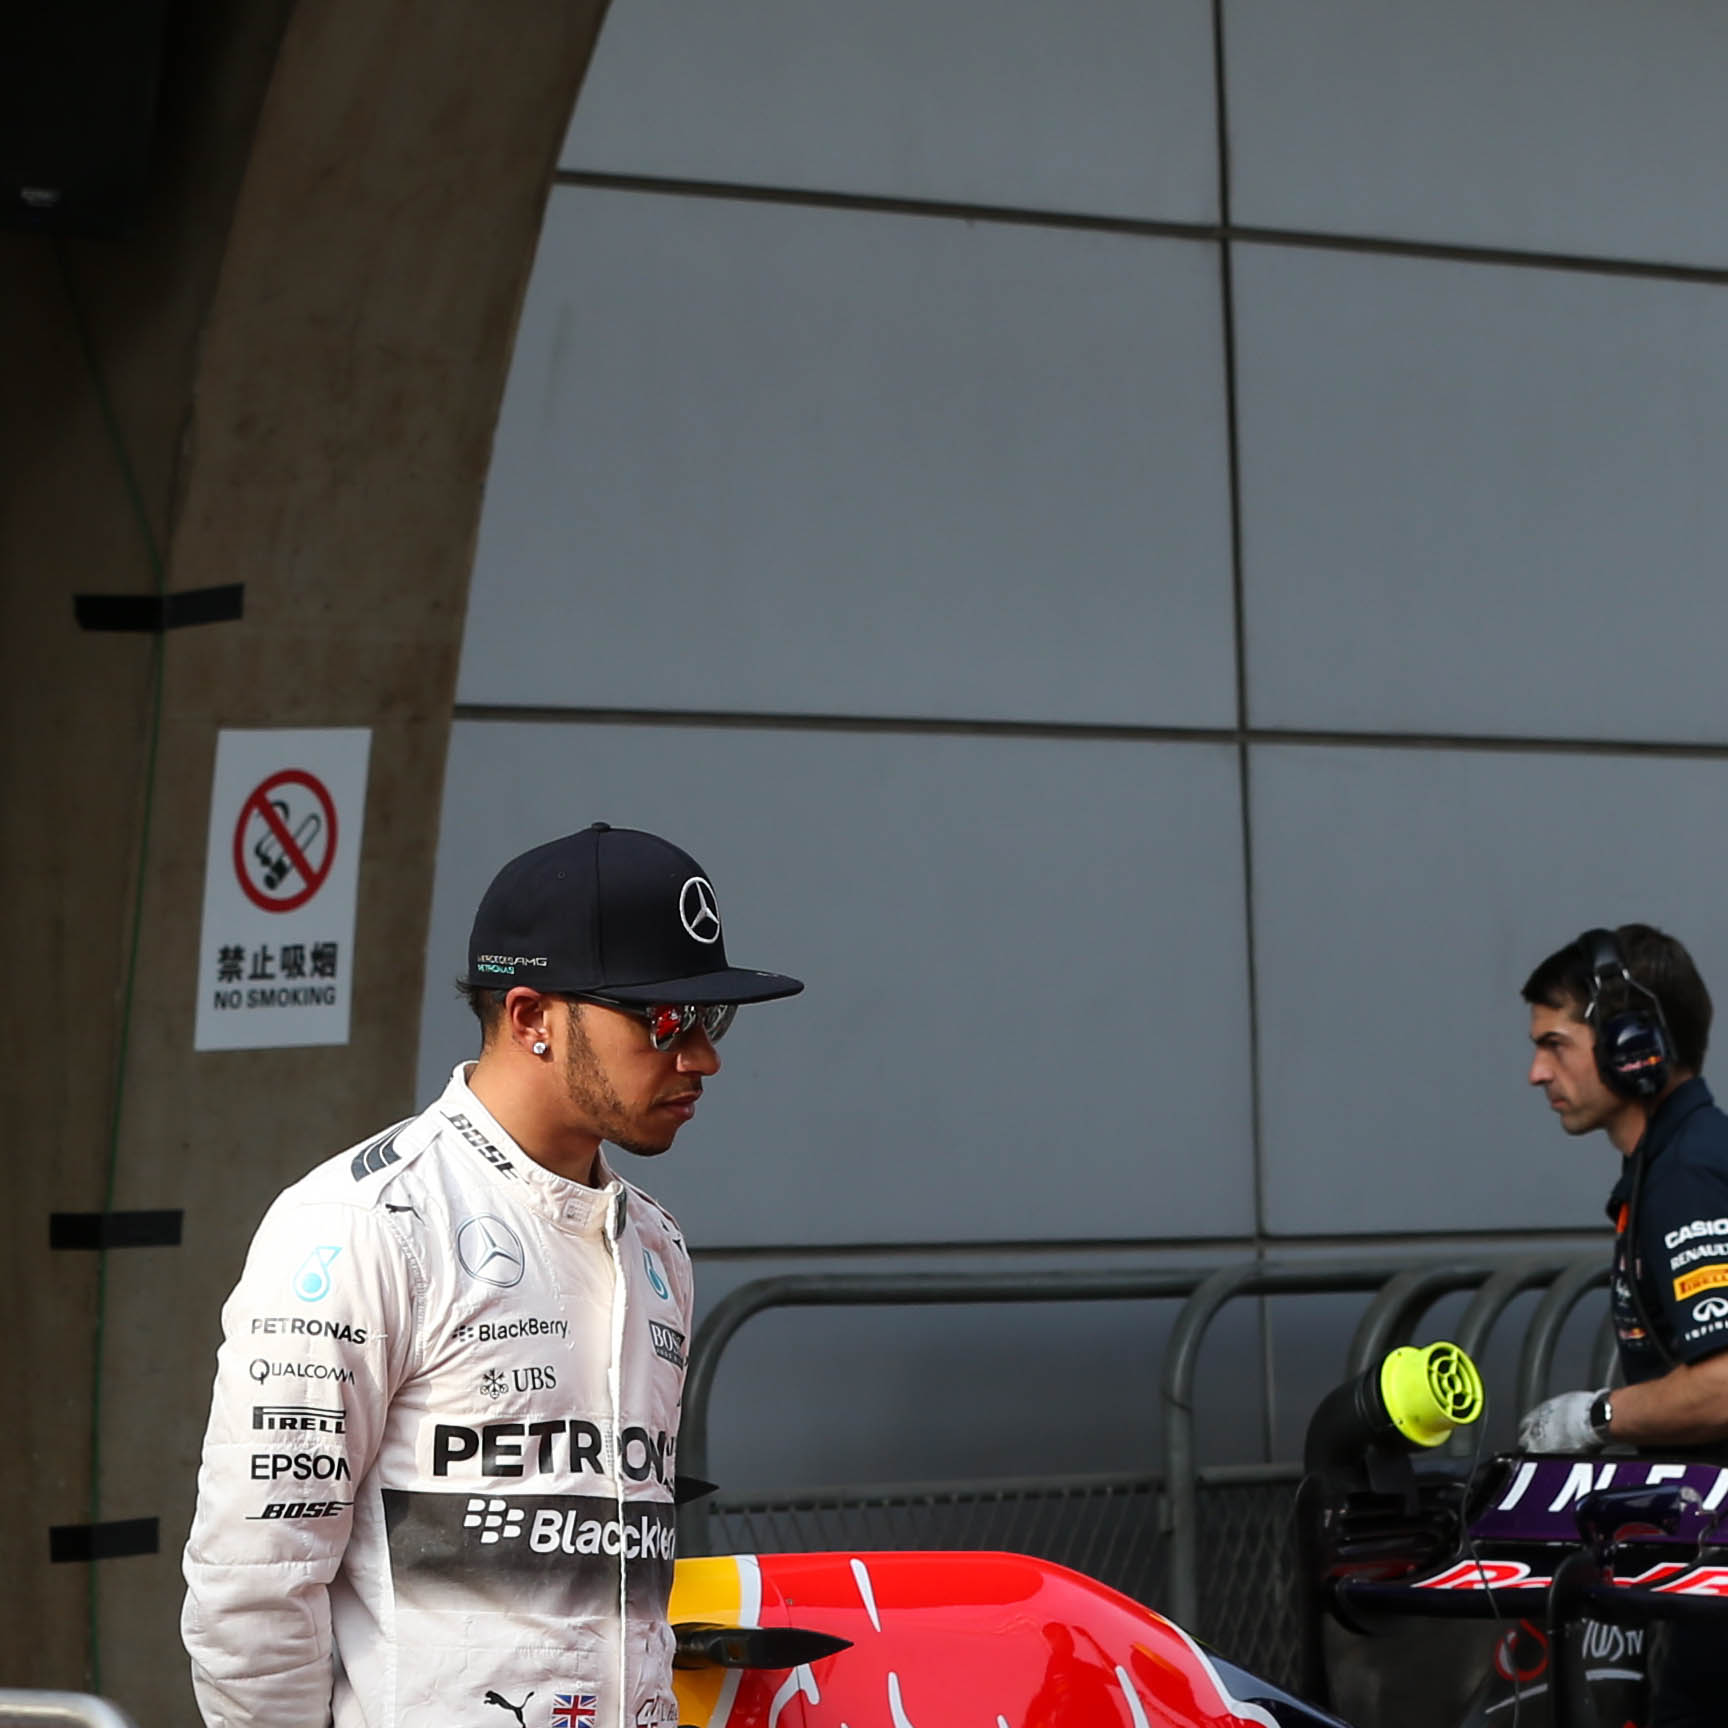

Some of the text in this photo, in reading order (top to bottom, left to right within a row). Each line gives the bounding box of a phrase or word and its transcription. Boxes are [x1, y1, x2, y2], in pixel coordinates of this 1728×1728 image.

[216, 942, 338, 983] 禁止吸烟
[214, 986, 337, 1011] NO SMOKING
[447, 1112, 522, 1181] BOSE
[251, 1317, 367, 1345] PETRONAS
[478, 1317, 569, 1343] BlackBerry
[513, 1366, 557, 1393] UBS
[250, 1501, 352, 1521] BOSE
